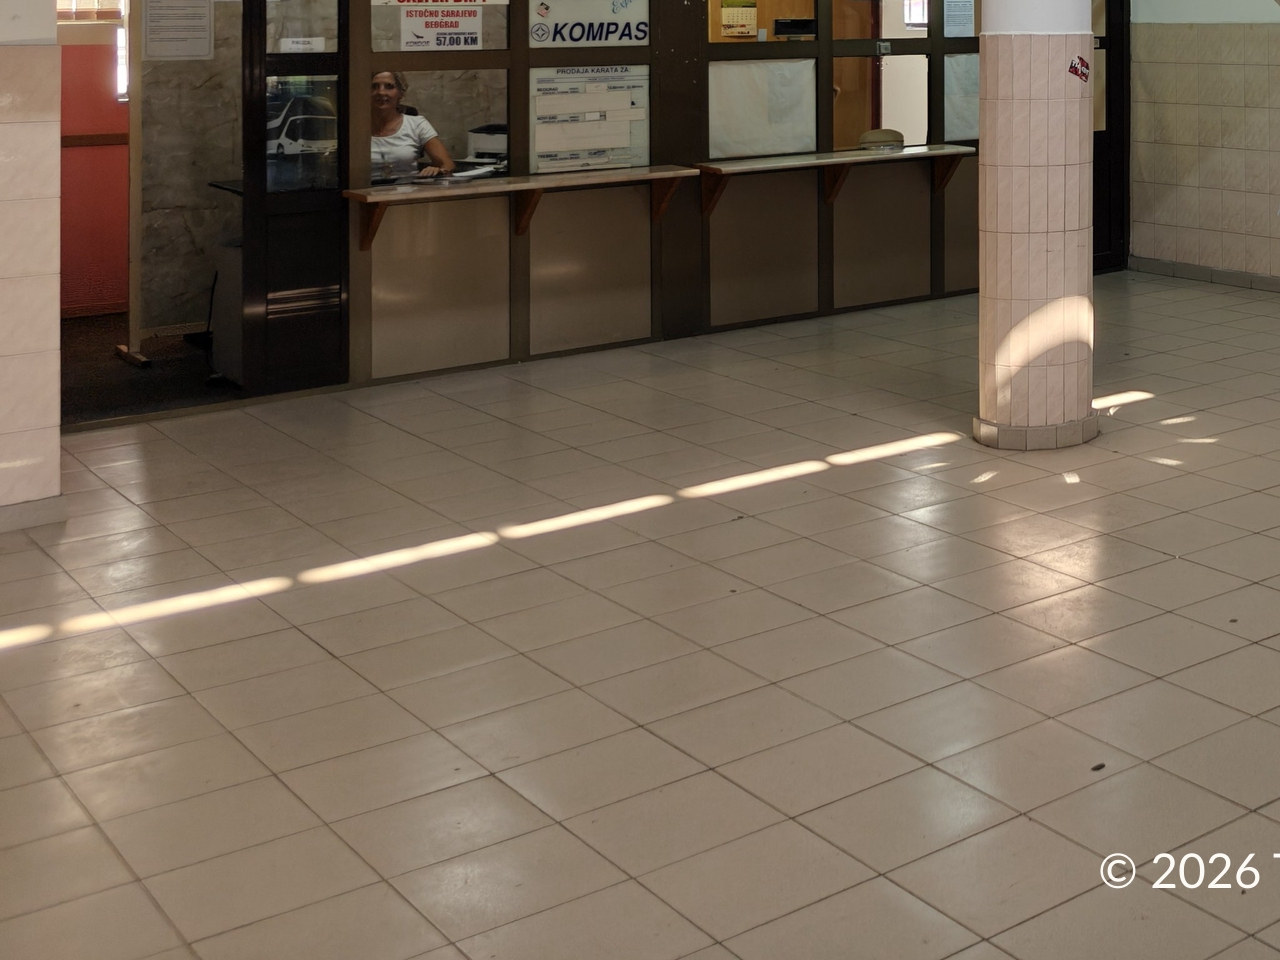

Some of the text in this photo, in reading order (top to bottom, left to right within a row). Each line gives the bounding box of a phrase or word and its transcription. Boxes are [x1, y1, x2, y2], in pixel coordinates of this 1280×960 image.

[405, 8, 478, 19] ISTOČNO SARAJEVO
[424, 20, 460, 29] BEOGRAD
[551, 21, 650, 43] KOMPAS
[436, 36, 479, 47] 57,00 KM
